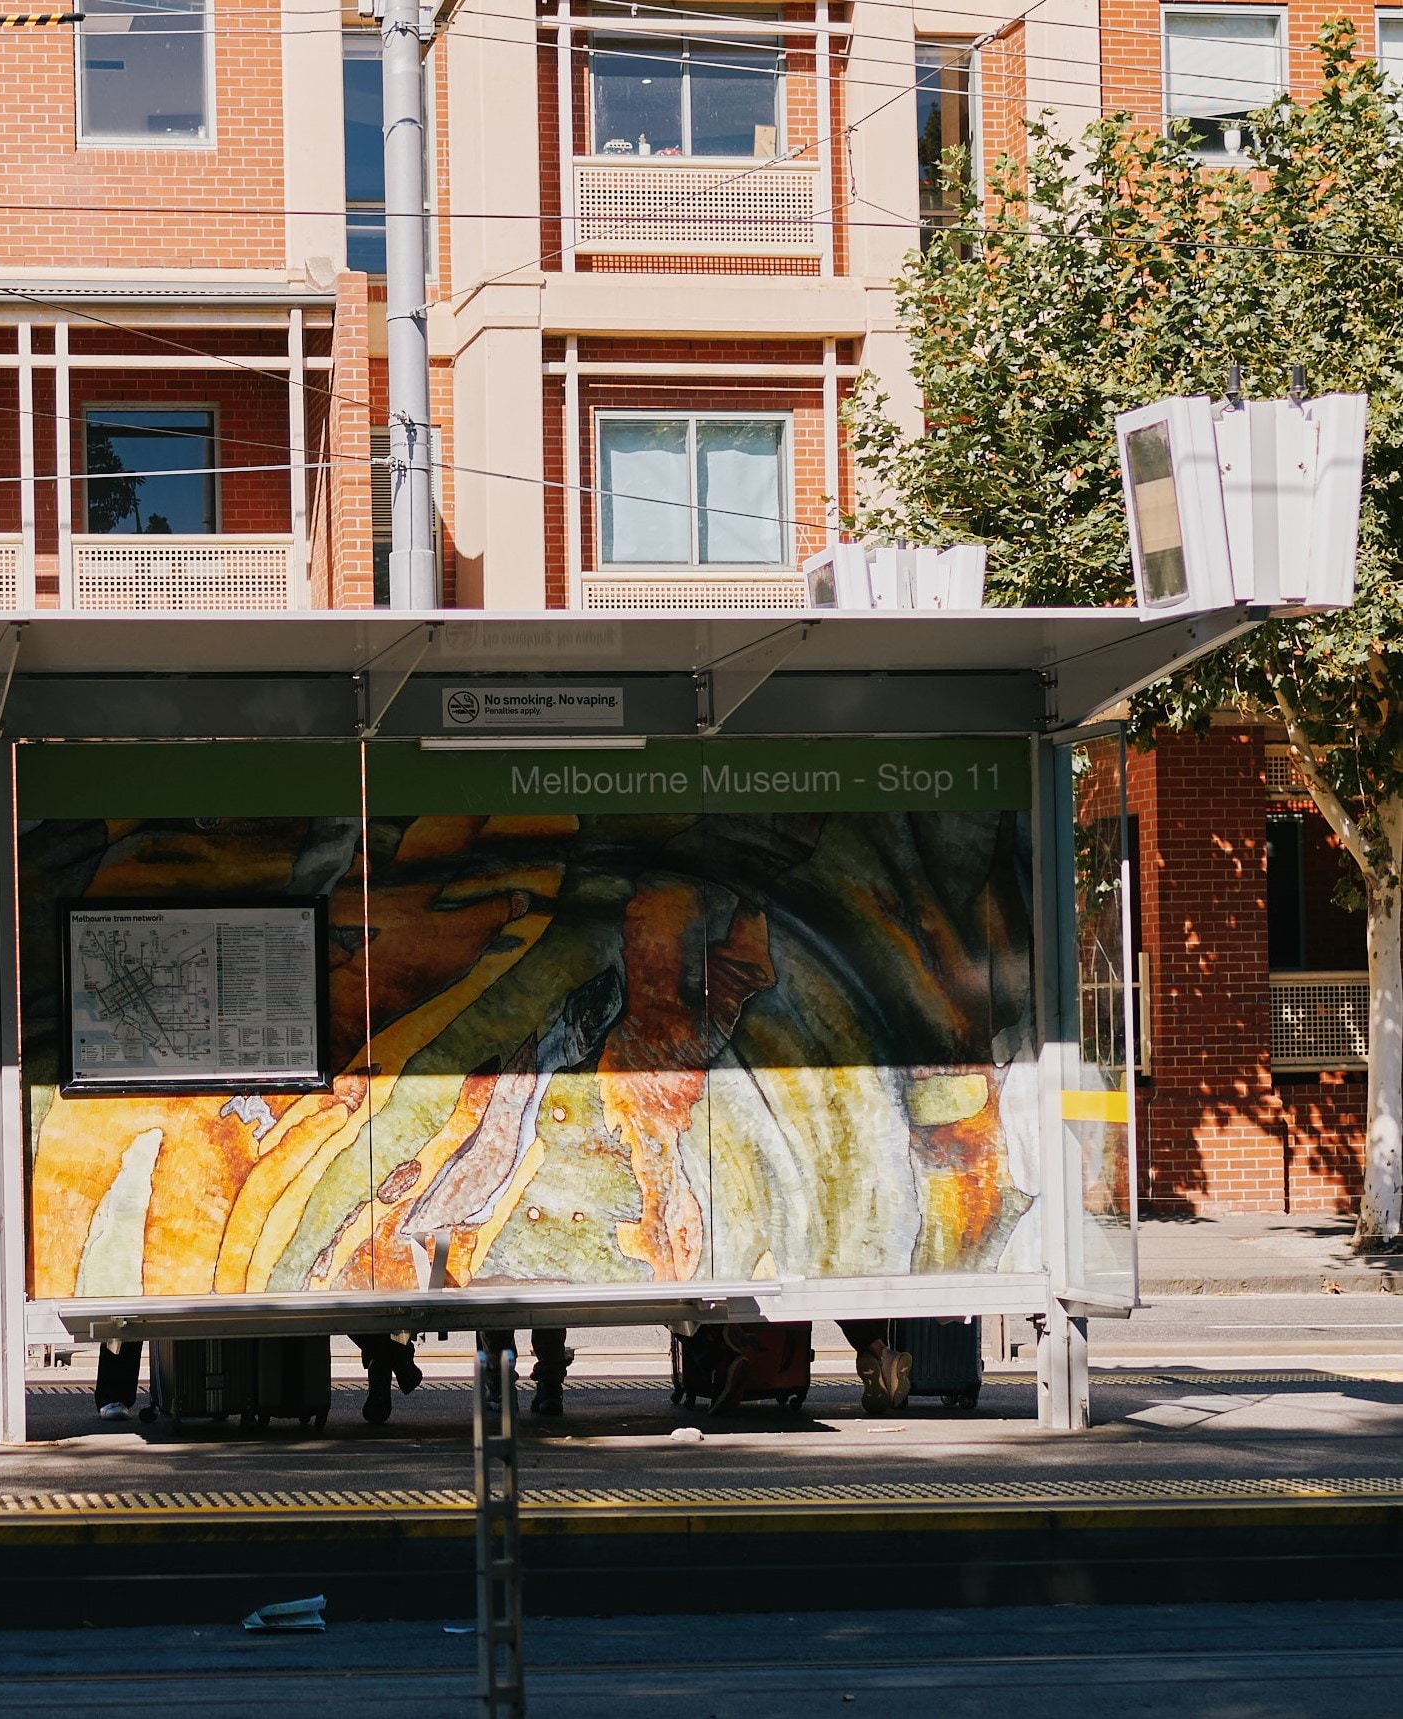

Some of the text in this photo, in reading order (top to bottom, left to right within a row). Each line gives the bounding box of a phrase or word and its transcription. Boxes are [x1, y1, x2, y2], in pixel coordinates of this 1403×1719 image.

[484, 694, 618, 707] No smoking. No vaping.
[485, 707, 542, 716] Penalties apply.
[511, 766, 688, 796] Melbourne
[703, 765, 841, 794] Museum
[878, 764, 954, 799] Stop
[968, 764, 1000, 791] 11
[71, 915, 112, 923] Melbourne
